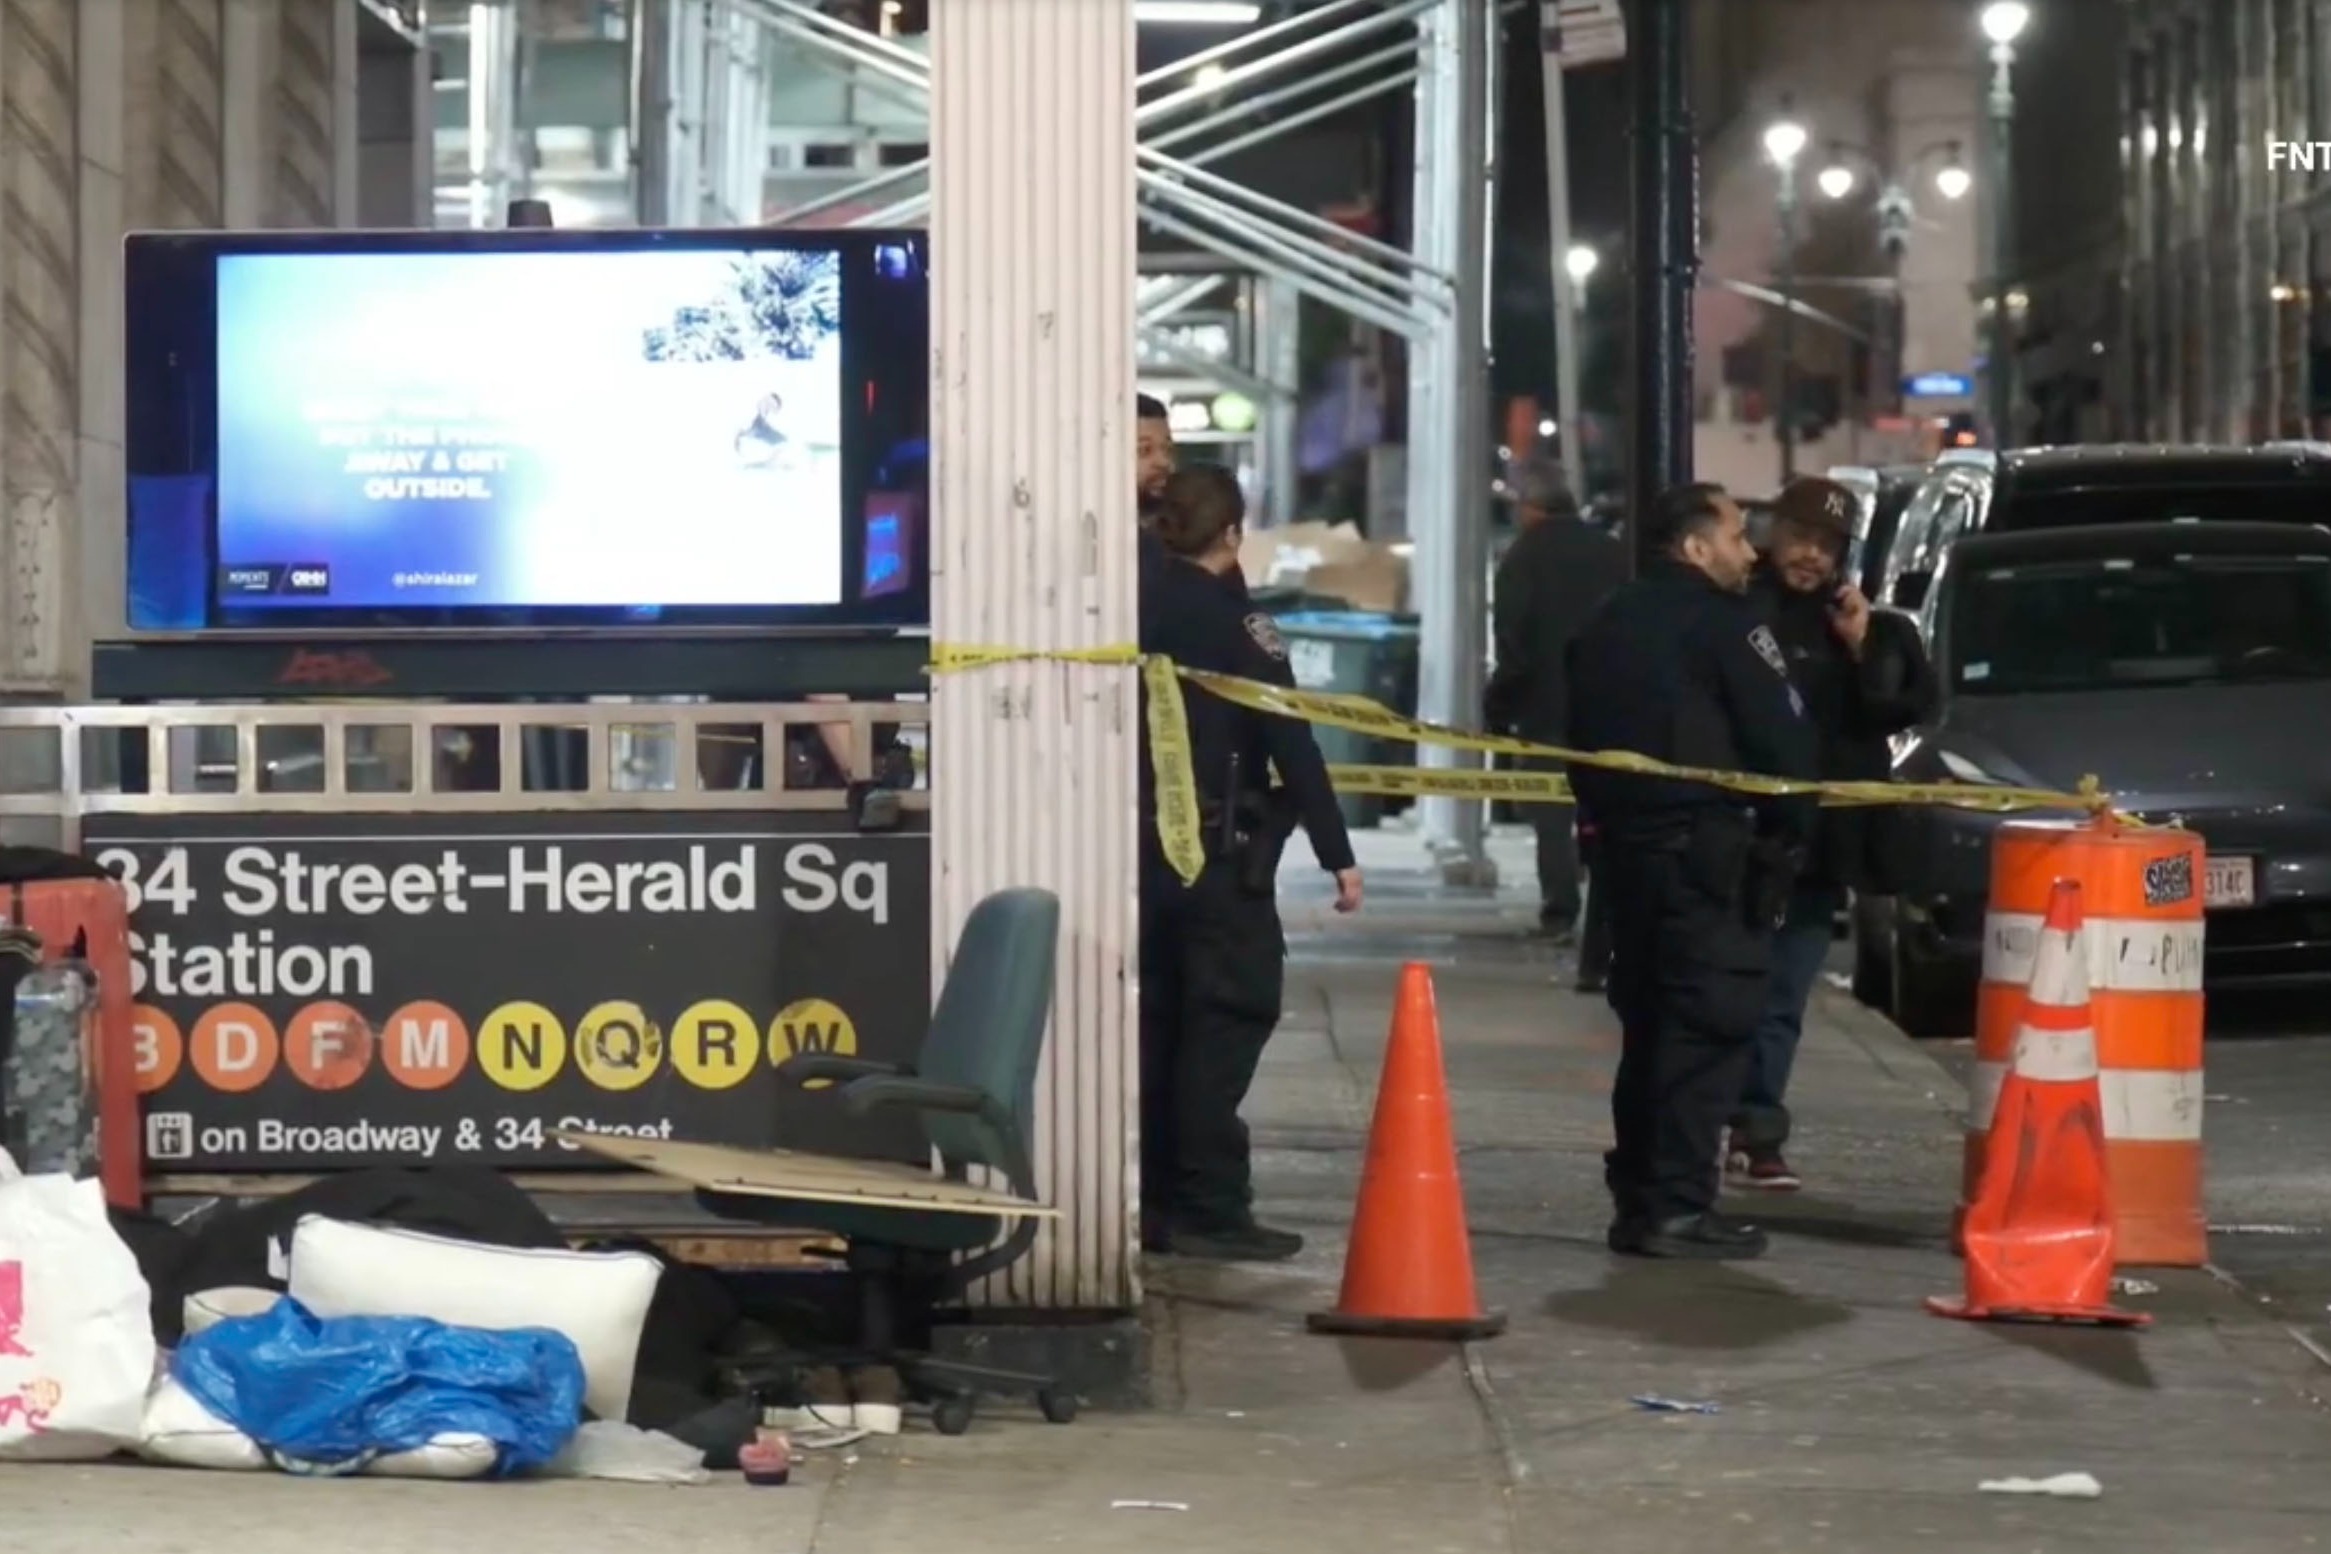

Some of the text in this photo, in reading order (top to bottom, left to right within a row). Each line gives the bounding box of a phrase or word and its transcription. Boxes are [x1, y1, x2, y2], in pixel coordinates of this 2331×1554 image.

[456, 451, 508, 471] GET
[364, 478, 492, 498] OUTSIDE.
[96, 844, 888, 924] 34 Street-Herald Sq
[215, 1021, 258, 1071] D
[311, 1020, 346, 1070] F
[401, 1019, 449, 1069] M
[503, 1022, 542, 1070] N
[596, 1019, 640, 1069] Q
[697, 1020, 737, 1067] R
[783, 1021, 840, 1054] W
[200, 1127, 247, 1152] on
[258, 1118, 442, 1159] Broadway
[454, 1118, 482, 1151] &
[495, 1116, 545, 1150] 34
